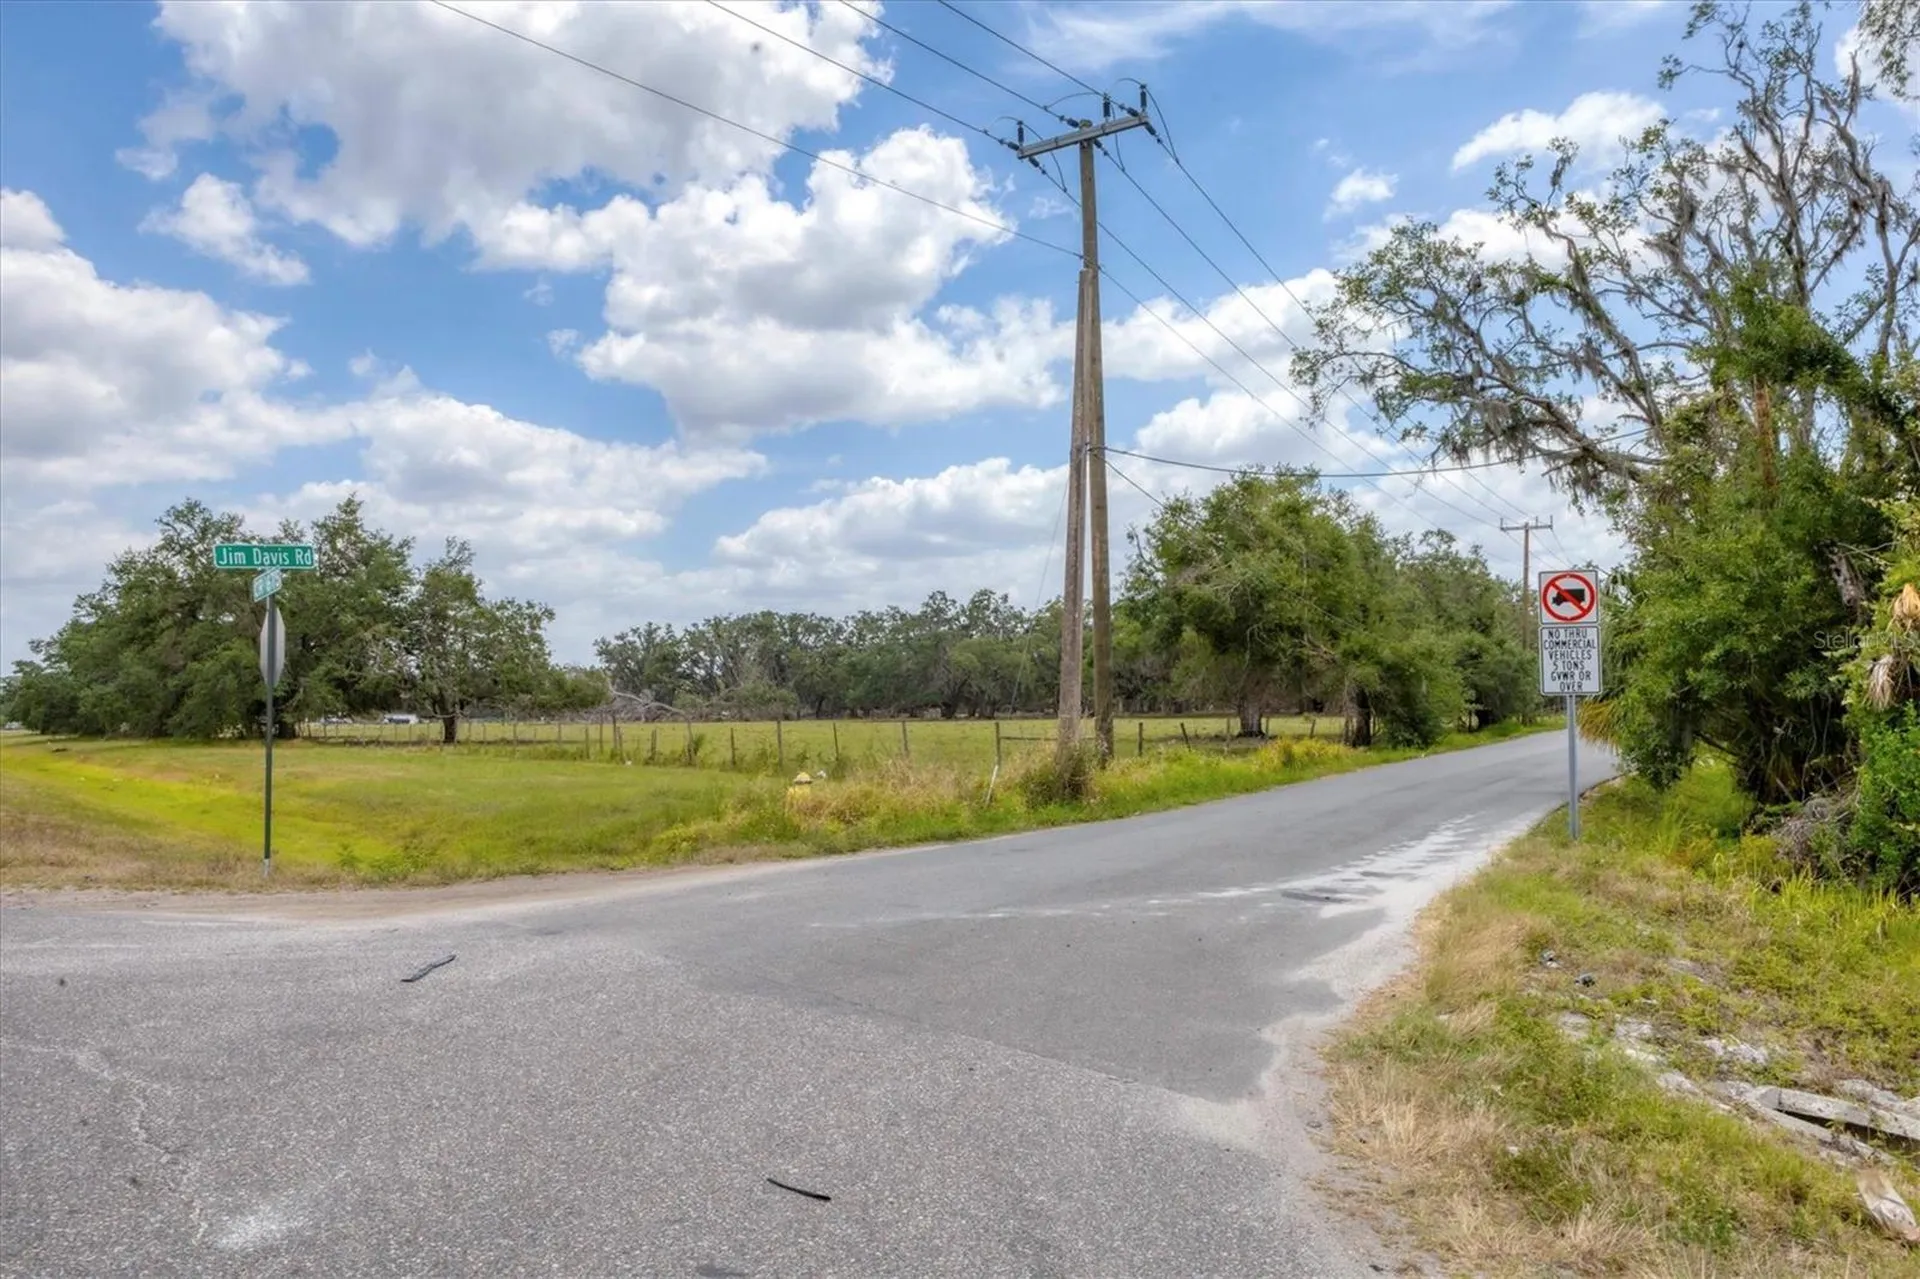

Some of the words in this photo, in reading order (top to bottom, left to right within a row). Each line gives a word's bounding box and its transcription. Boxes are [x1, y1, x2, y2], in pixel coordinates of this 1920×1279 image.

[218, 547, 246, 565] Jim
[252, 547, 290, 565] Davis
[295, 548, 312, 565] Rd
[1548, 629, 1560, 639] NO
[1564, 629, 1587, 639] THRU
[1543, 640, 1596, 650] COMMERCIAL
[1548, 650, 1592, 660] VEHICLES
[1553, 661, 1559, 670] 5
[1562, 661, 1585, 671] TONS
[1550, 671, 1575, 681] GVWR
[1578, 671, 1591, 680] OR
[1559, 681, 1583, 692] OVER
